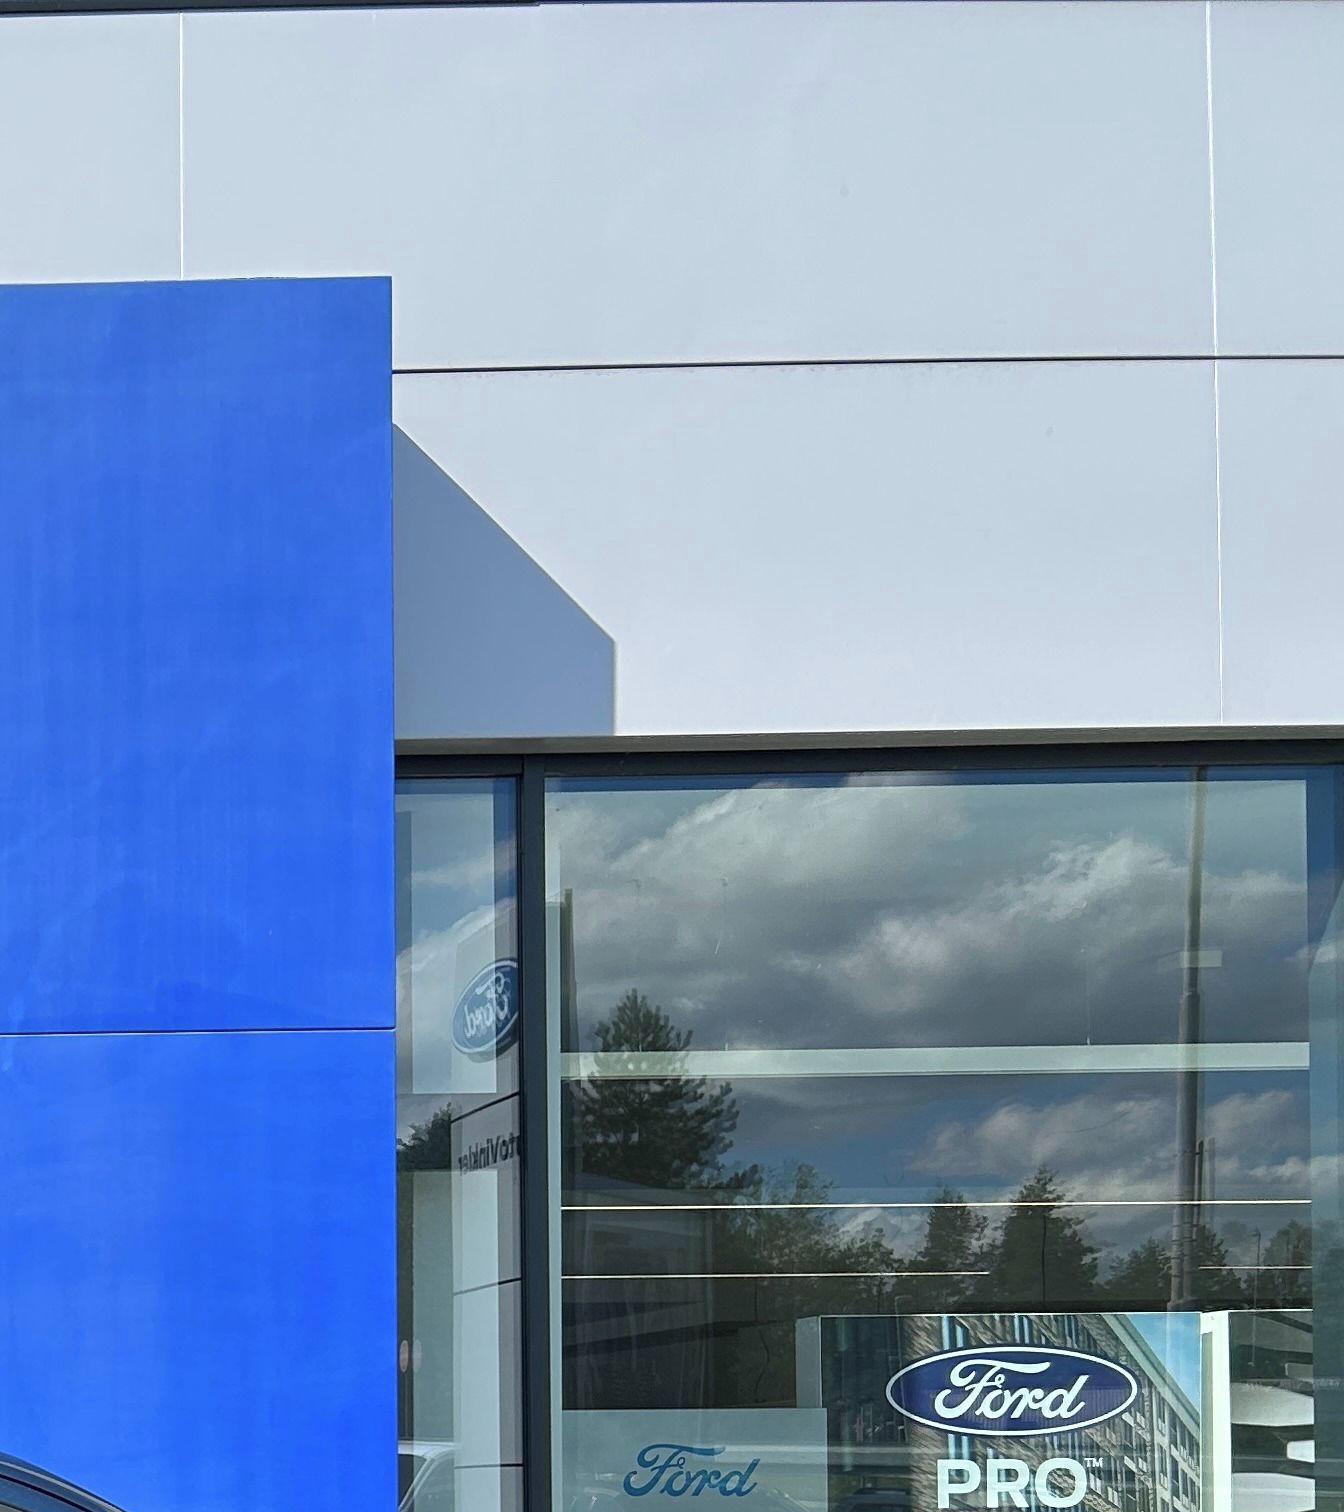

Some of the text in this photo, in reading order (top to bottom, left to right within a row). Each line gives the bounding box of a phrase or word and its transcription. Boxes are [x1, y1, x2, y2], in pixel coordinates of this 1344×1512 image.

[933, 1358, 1090, 1419] Ford
[623, 1443, 761, 1497] Ford
[936, 1457, 1088, 1509] PRO
